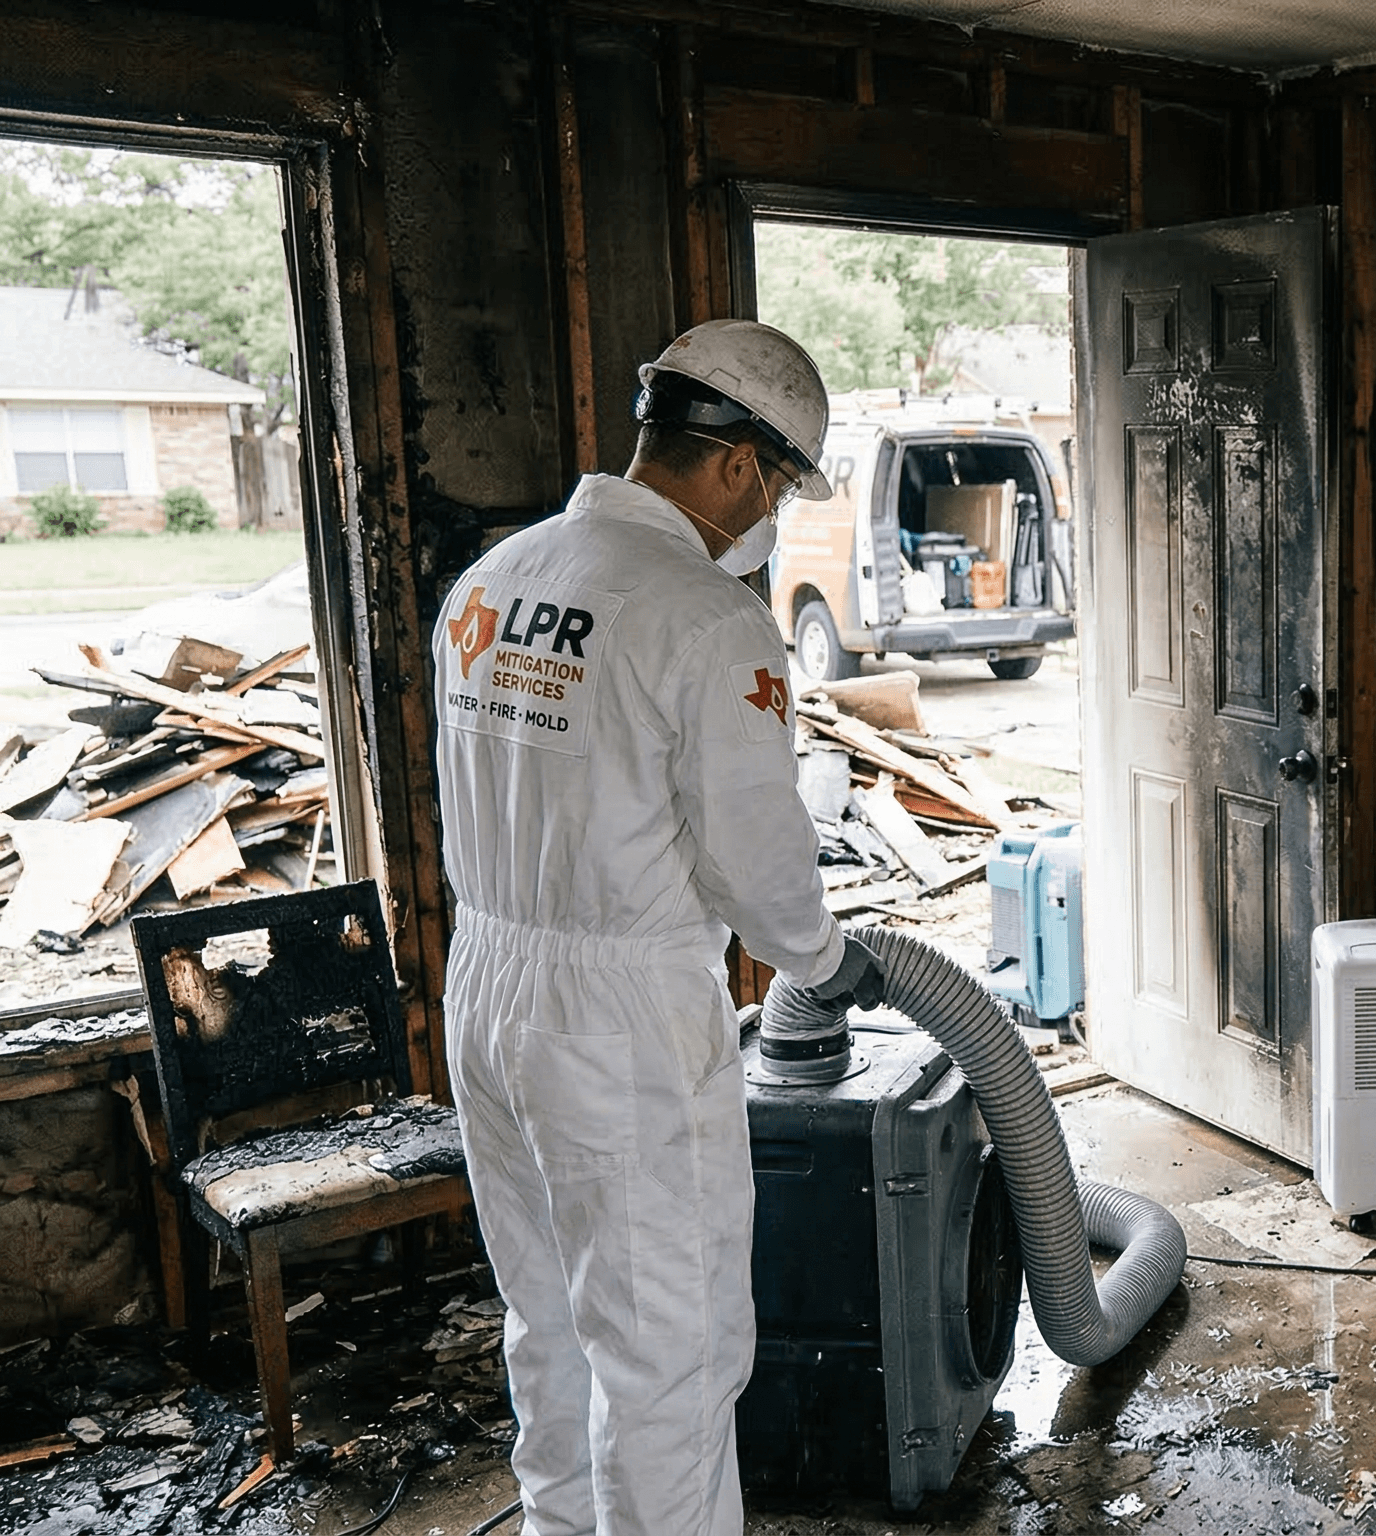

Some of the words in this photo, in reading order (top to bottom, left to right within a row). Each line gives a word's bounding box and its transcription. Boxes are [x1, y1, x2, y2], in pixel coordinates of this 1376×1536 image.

[500, 597, 595, 659] LPR
[494, 649, 585, 684] MITIGATION
[491, 670, 566, 701] SERVICES
[448, 692, 478, 712] WATER
[489, 701, 517, 721] FIRE
[525, 709, 569, 732] MOLD
